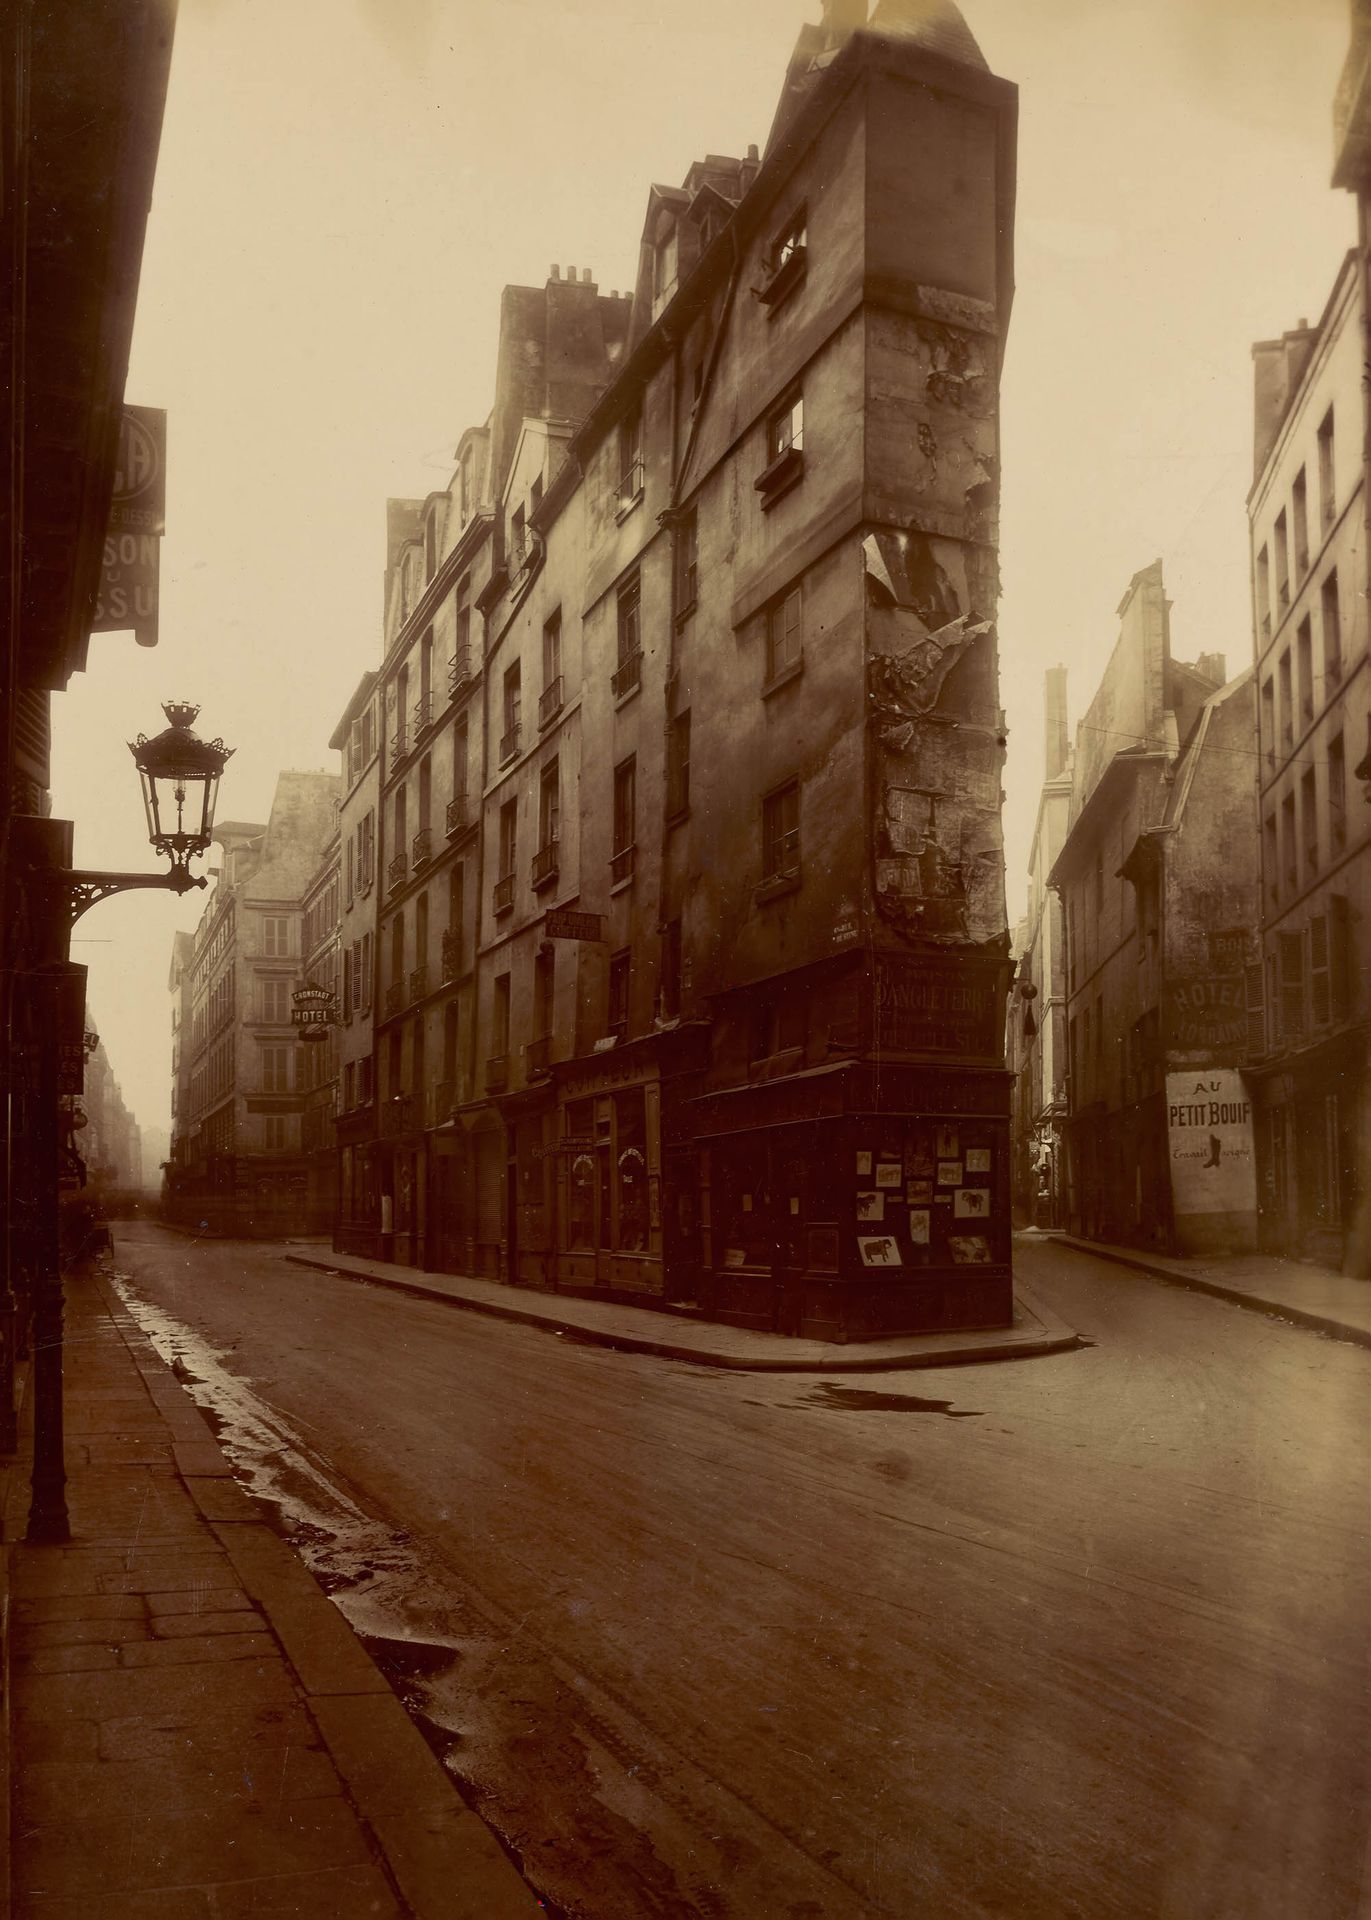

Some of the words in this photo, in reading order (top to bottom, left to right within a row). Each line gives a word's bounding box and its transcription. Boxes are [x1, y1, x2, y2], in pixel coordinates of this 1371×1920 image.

[1174, 983, 1244, 1012] HOTEL
[294, 1010, 328, 1022] HOTEL
[1193, 1081, 1221, 1095] AU
[1170, 1104, 1206, 1127] PETIT
[1208, 1102, 1250, 1126] BOUIF
